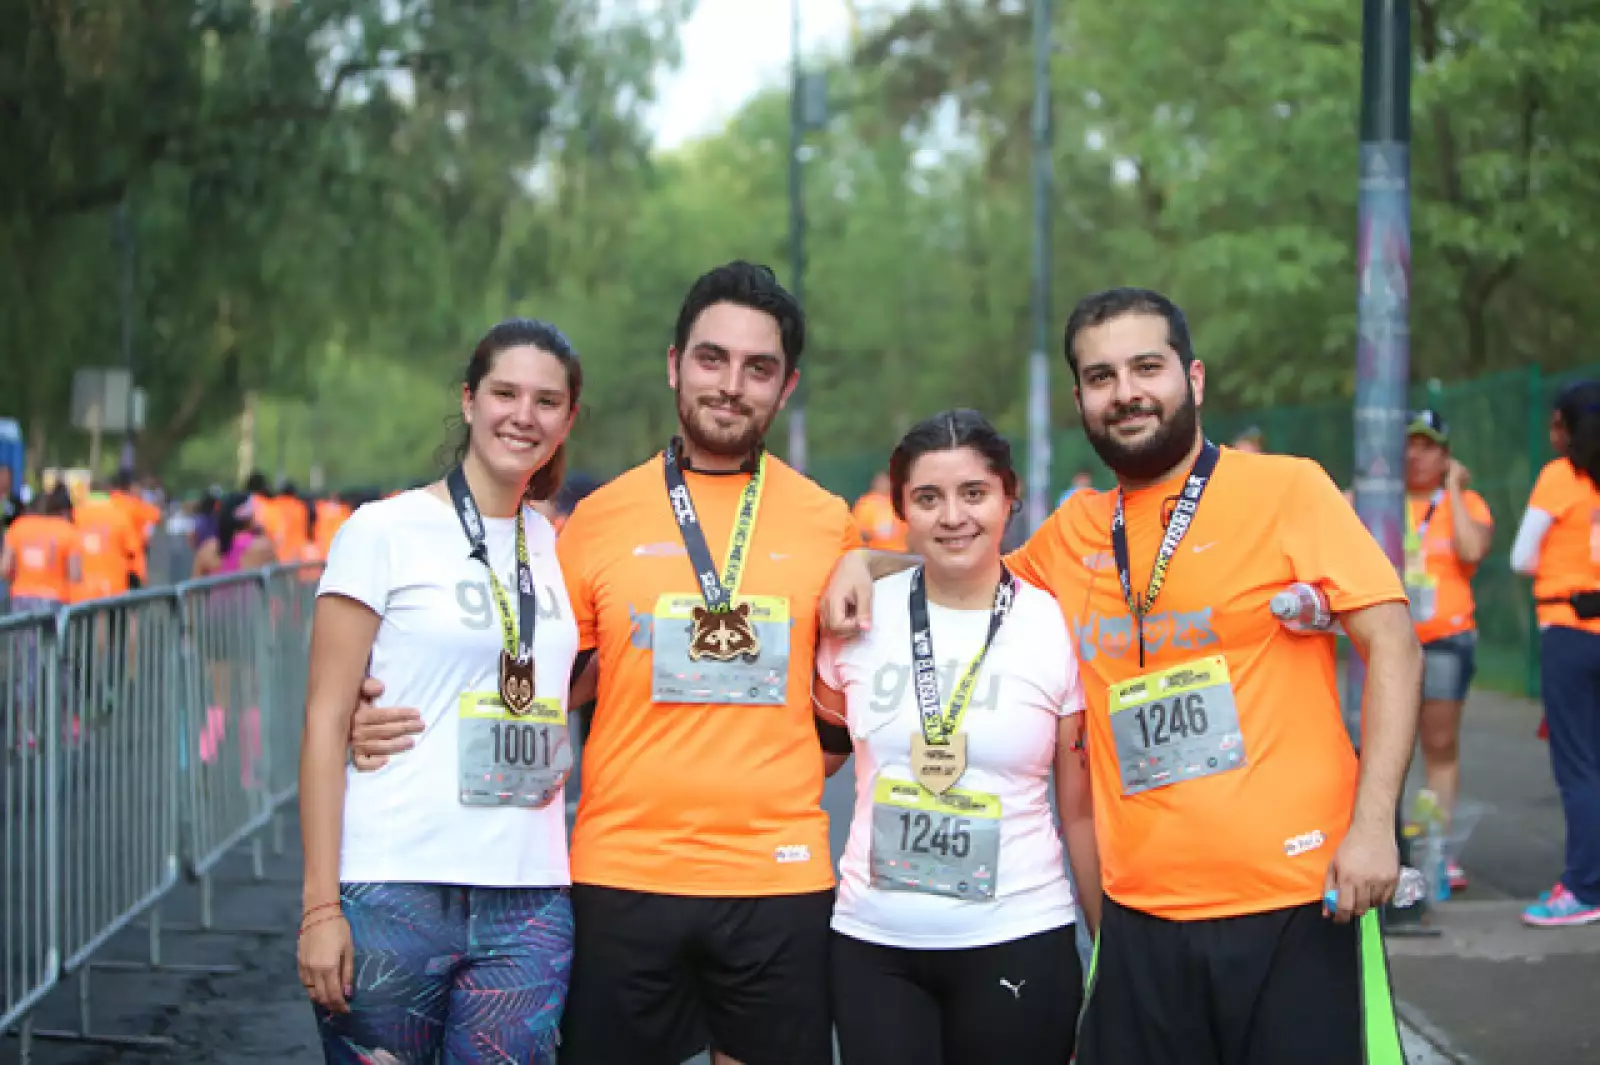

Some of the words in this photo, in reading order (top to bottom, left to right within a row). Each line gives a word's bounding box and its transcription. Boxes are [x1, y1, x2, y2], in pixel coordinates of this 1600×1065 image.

[1135, 693, 1208, 748] 1246
[490, 724, 549, 766] 1001
[900, 811, 971, 859] 1245
